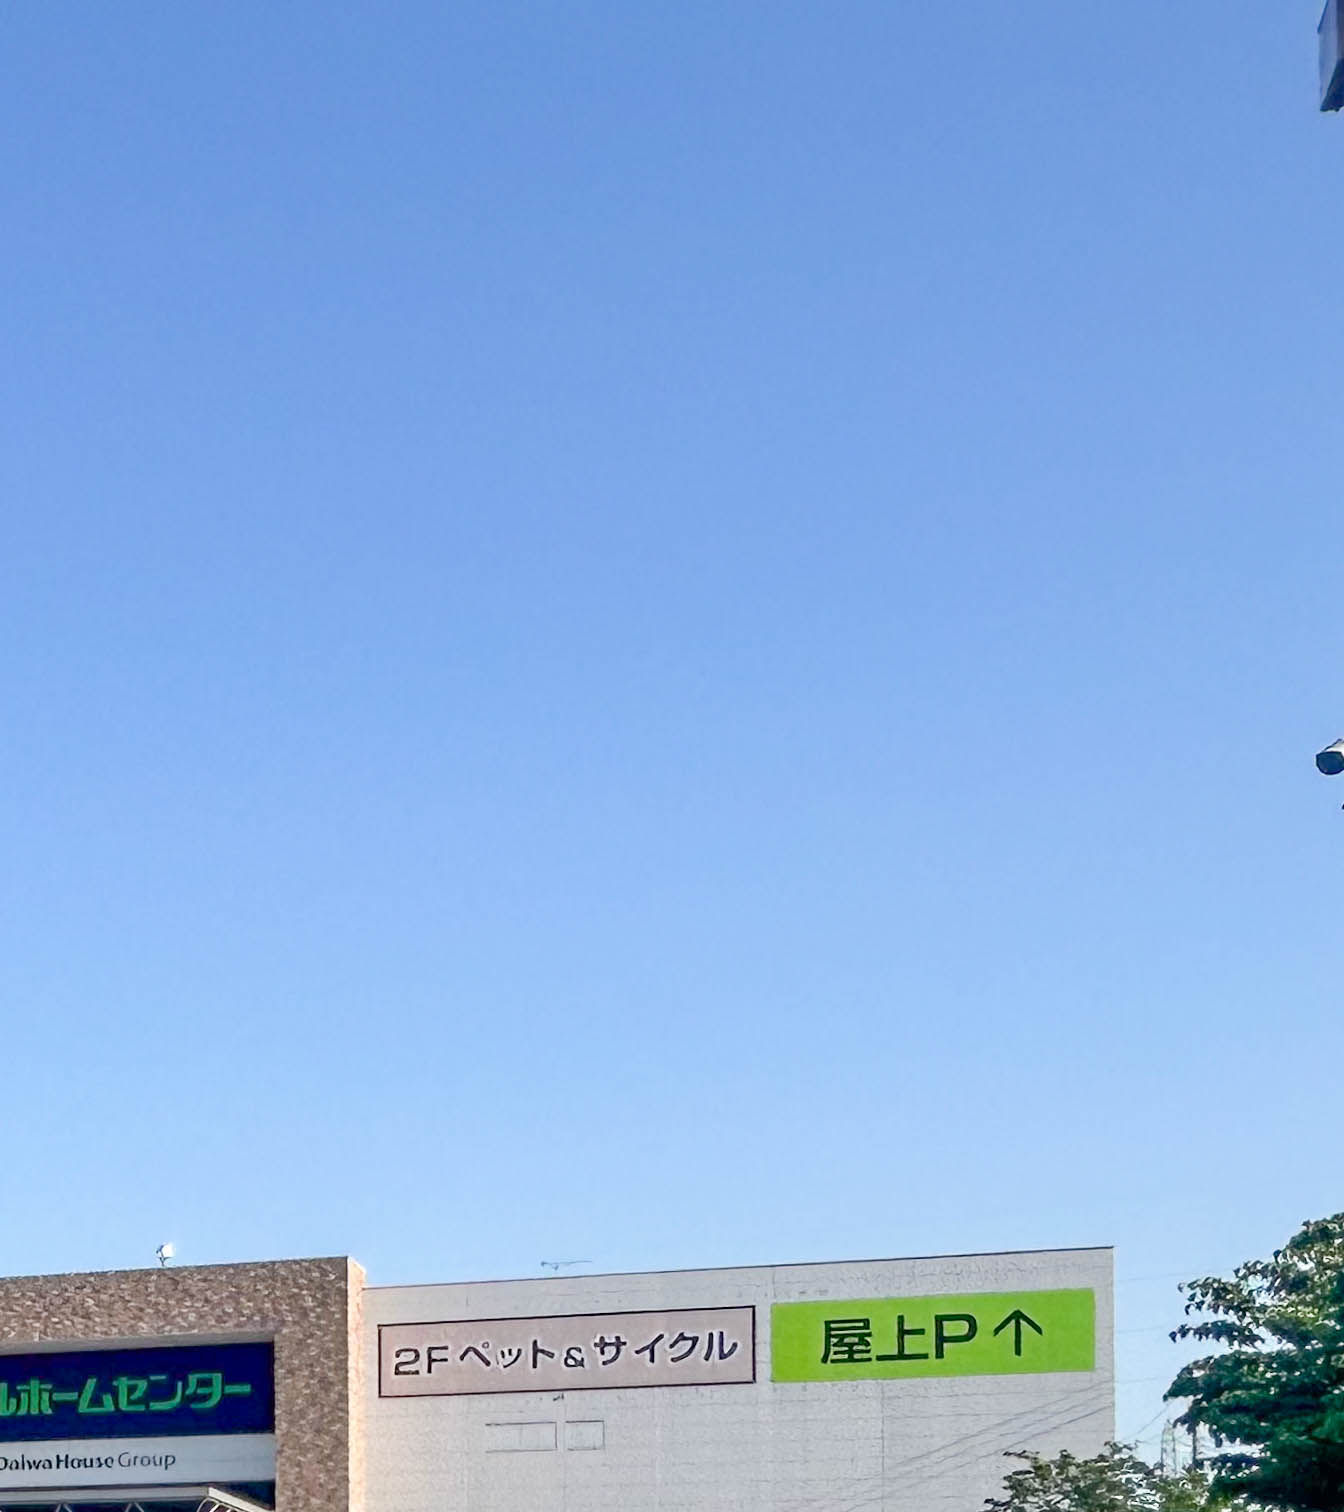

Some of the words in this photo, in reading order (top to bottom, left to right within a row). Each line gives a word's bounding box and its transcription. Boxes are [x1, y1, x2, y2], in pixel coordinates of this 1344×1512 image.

[820, 1313, 978, 1366] 屋上P
[56, 1453, 114, 1470] House
[117, 1452, 176, 1471] Group
